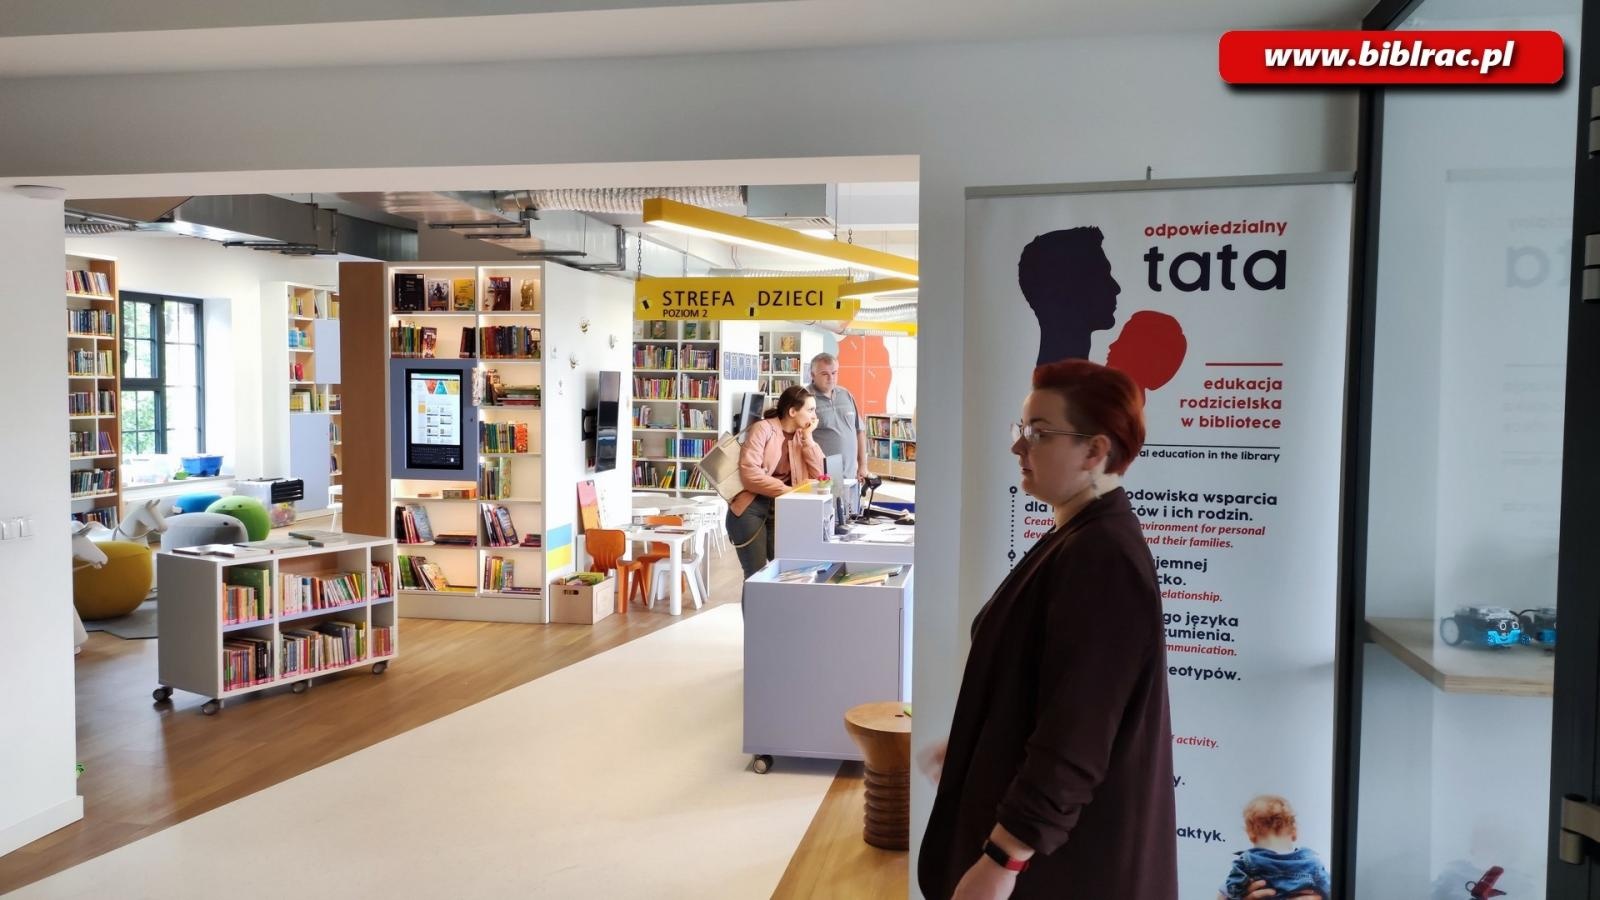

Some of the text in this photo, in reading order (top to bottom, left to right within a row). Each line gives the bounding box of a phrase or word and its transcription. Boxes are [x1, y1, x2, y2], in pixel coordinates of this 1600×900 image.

[1144, 220, 1287, 239] odpowiedzialny
[1143, 244, 1287, 292] tata
[662, 290, 823, 306] STREFA DZIECI
[663, 309, 708, 318] POZIOM 2
[1203, 377, 1283, 393] edukacja
[1180, 397, 1282, 411] rodzicielska
[1181, 416, 1281, 429] w bibliotece
[1138, 449, 1280, 463] al education in the library
[1203, 493, 1277, 505] wsparcia
[1025, 501, 1047, 512] dla
[1163, 506, 1167, 517] i
[1172, 506, 1193, 518] ich
[1198, 508, 1253, 521] rodzin.
[1201, 524, 1216, 535] for
[1218, 525, 1266, 536] personal
[1144, 536, 1160, 544] nd
[1163, 536, 1186, 546] their
[1189, 537, 1233, 548] families.
[1154, 556, 1207, 573] jemnej
[1160, 589, 1222, 603] elationship.
[1185, 611, 1239, 628] języka
[1167, 666, 1241, 680] eotypów.
[1176, 736, 1219, 748] activity.
